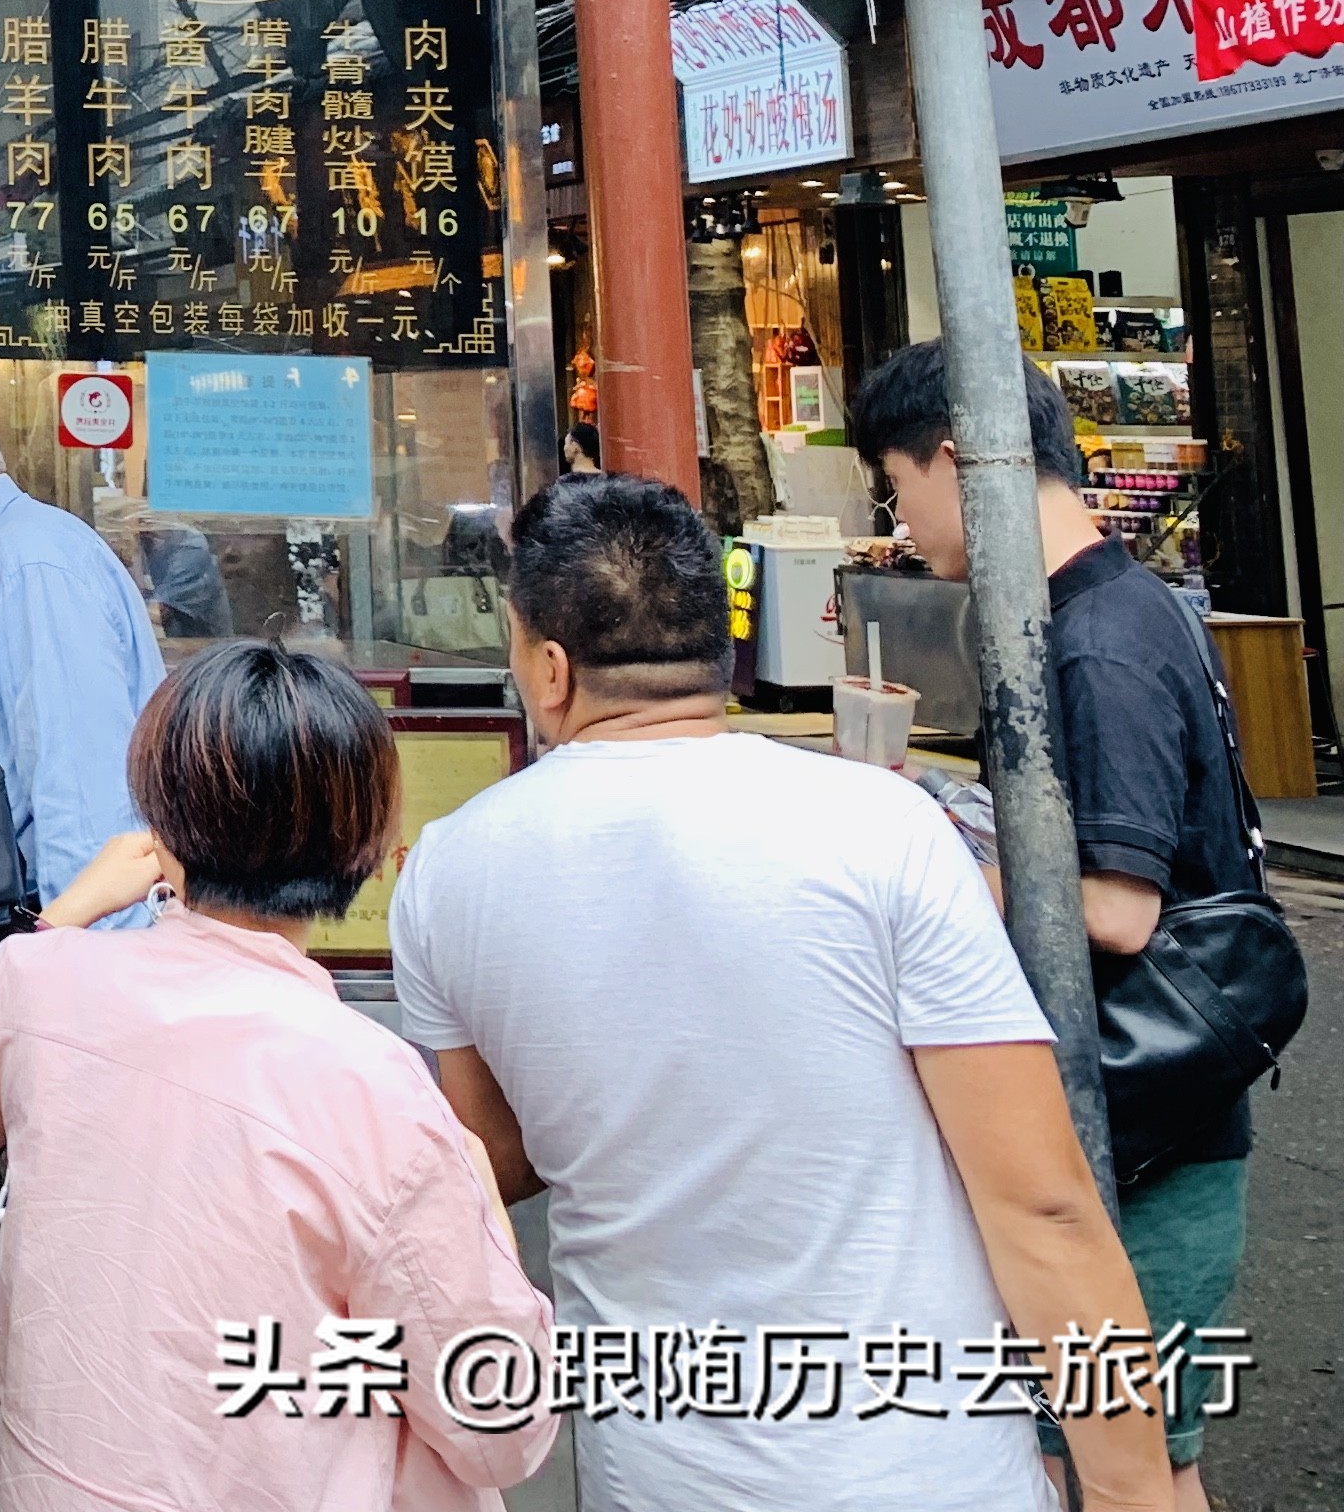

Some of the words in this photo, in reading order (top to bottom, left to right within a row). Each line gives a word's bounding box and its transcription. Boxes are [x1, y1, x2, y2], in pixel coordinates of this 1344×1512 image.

[1, 17, 54, 187] 腊羊肉
[81, 18, 132, 187] 腊牛肉
[160, 18, 213, 190] 酱牛肉
[241, 19, 296, 192] 腊牛肉腱子
[320, 21, 376, 190] 牛骨髓炒面
[404, 19, 458, 192] 肉夹馍
[6, 201, 51, 231] 77
[88, 204, 135, 232] 65
[168, 204, 215, 232] 67
[248, 205, 296, 233] 67
[332, 208, 377, 237] 10
[414, 209, 459, 237] 16
[87, 247, 137, 291] 元/斤
[167, 247, 215, 292] 元/斤
[248, 249, 299, 293] 元/斤
[44, 298, 419, 338] 抽真空包装每袋加收一元
